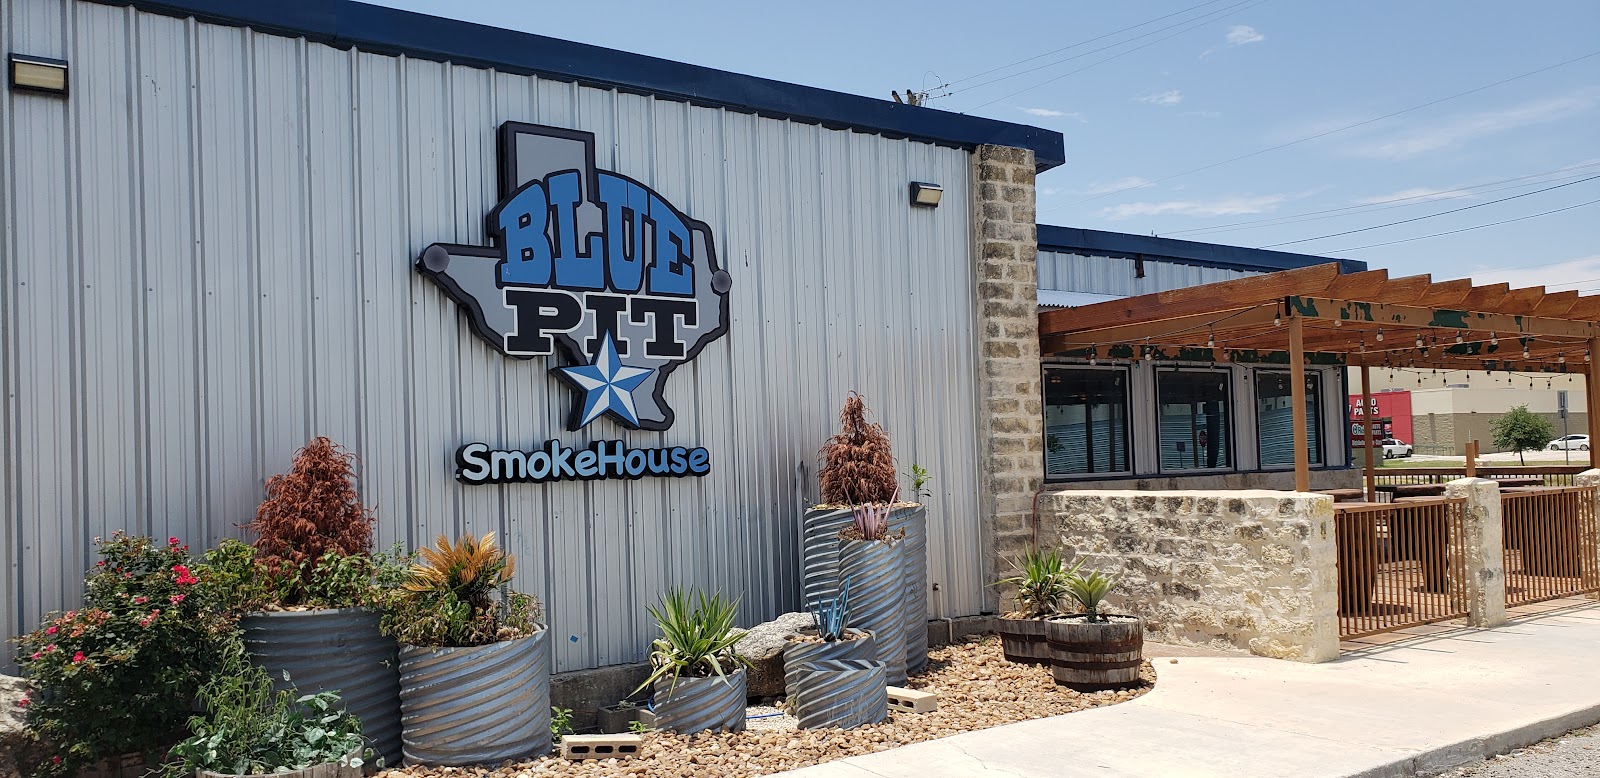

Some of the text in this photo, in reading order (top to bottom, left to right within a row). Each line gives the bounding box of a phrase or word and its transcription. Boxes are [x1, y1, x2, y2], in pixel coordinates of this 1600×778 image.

[498, 171, 695, 296] BLUE
[502, 286, 699, 360] PIT
[1353, 407, 1379, 415] PATS
[462, 439, 710, 482] SmokeHouse
